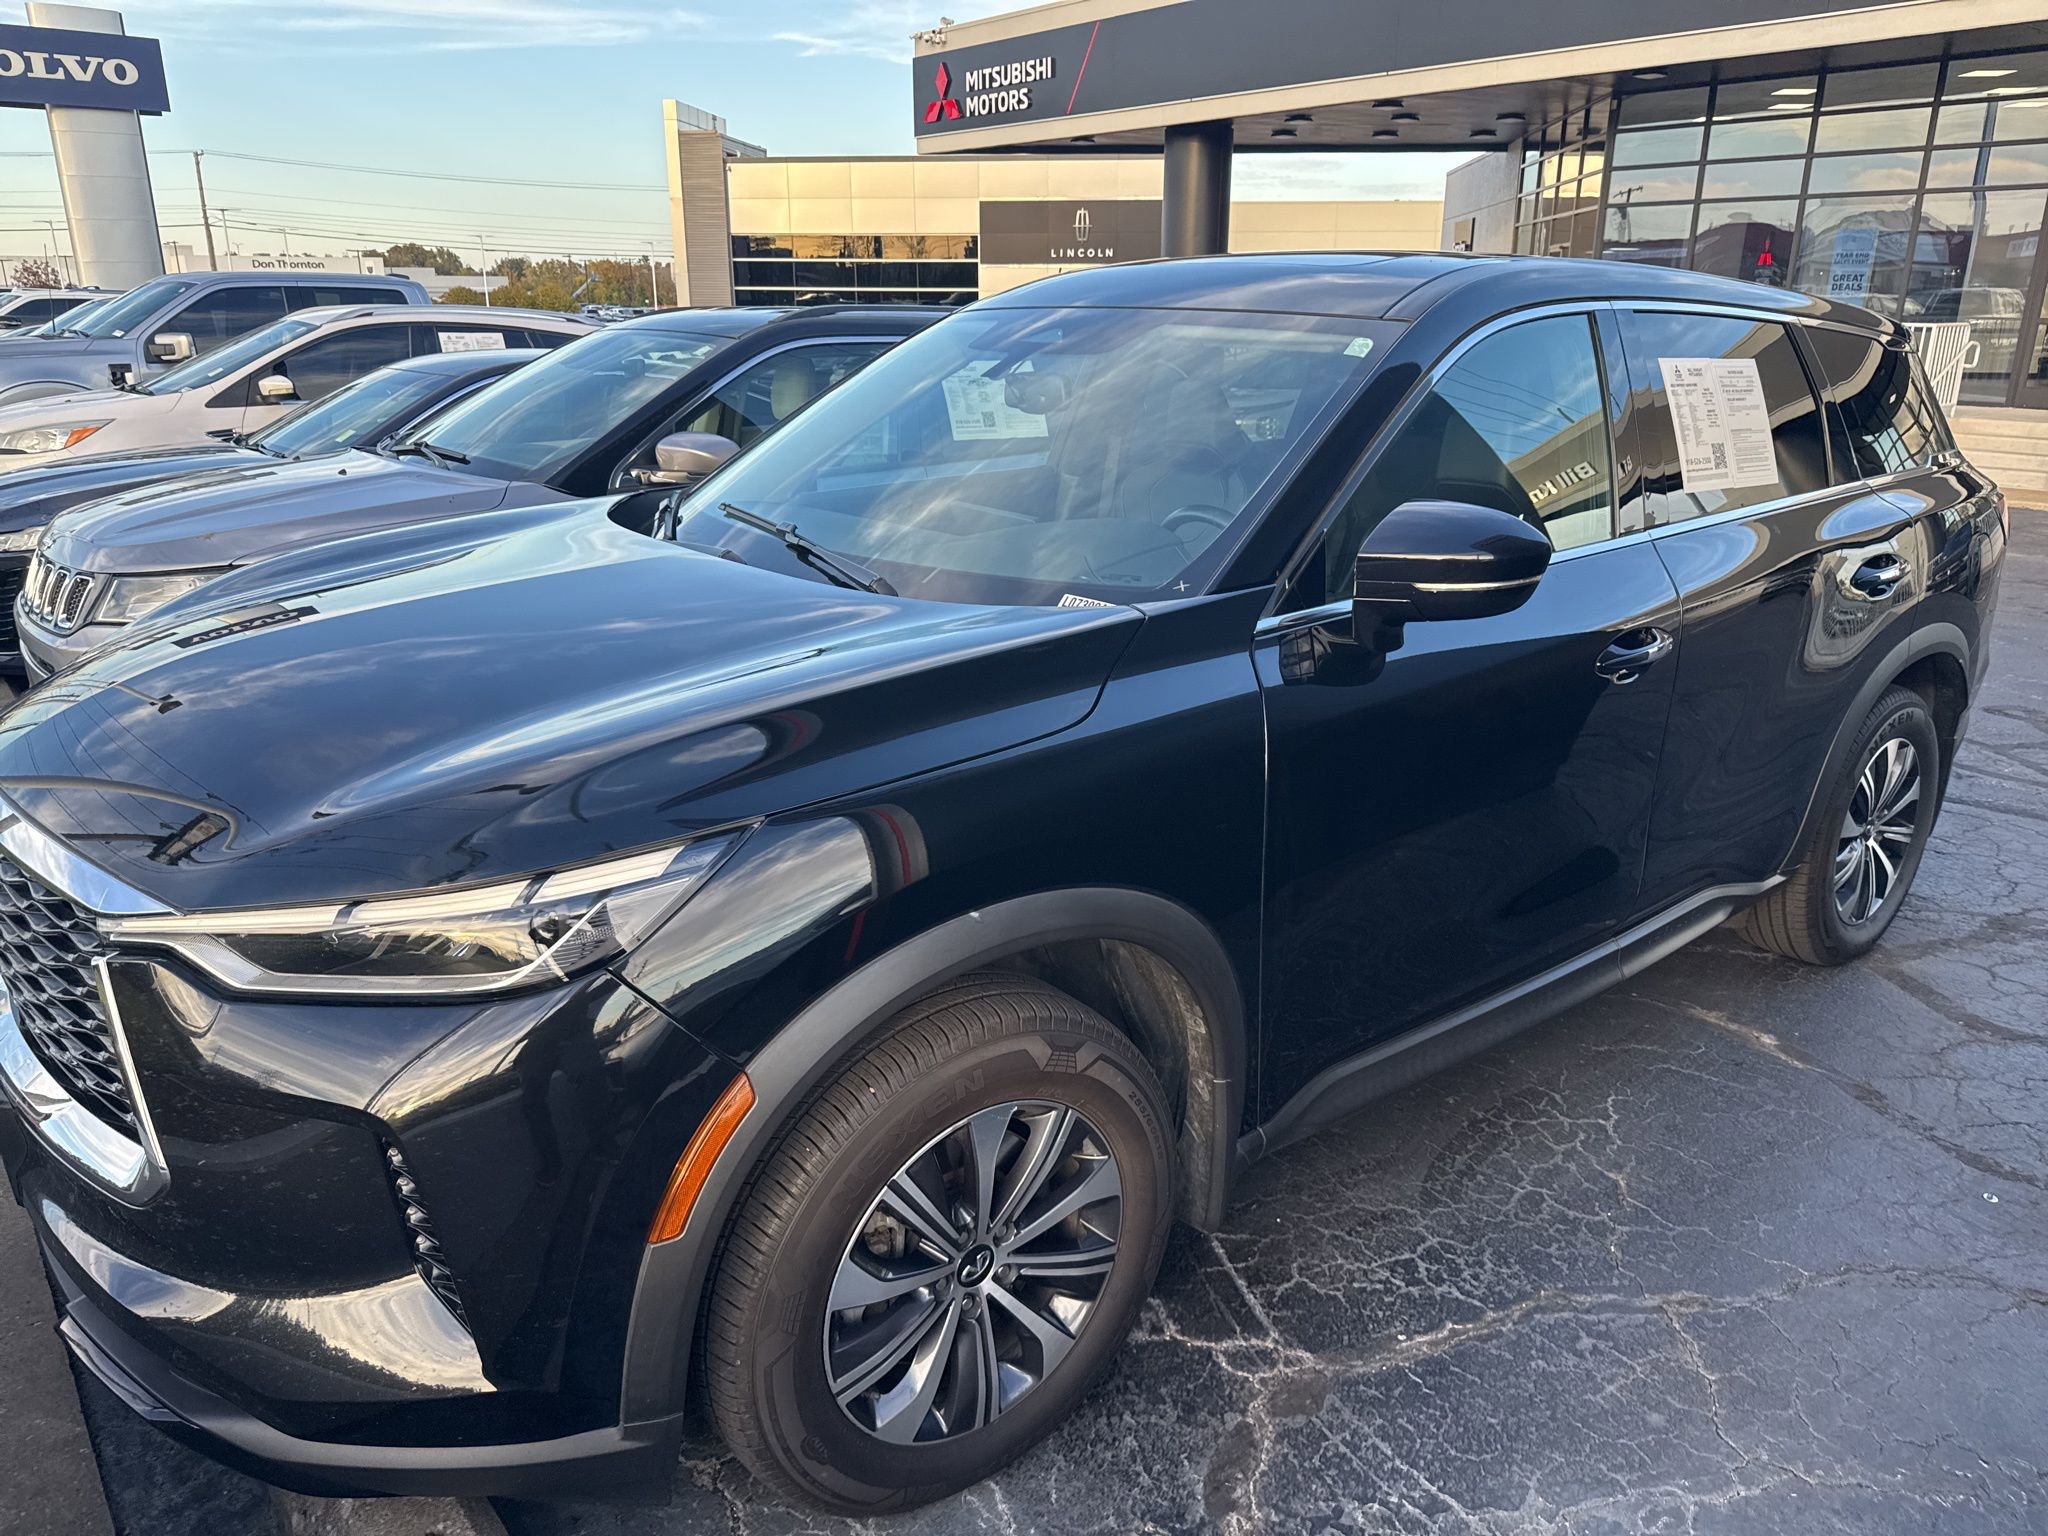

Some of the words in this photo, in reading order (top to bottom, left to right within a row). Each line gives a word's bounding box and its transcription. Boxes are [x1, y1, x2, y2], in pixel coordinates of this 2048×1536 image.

[965, 56, 1053, 93] MITSUBISHI
[965, 87, 1029, 118] MOTORS
[1050, 247, 1114, 258] LINCOLN
[252, 259, 275, 269] Don
[276, 259, 325, 269] Thornton
[1832, 273, 1865, 283] GREAT
[1831, 283, 1863, 292] DEALS
[1868, 710, 1914, 756] NEXEN
